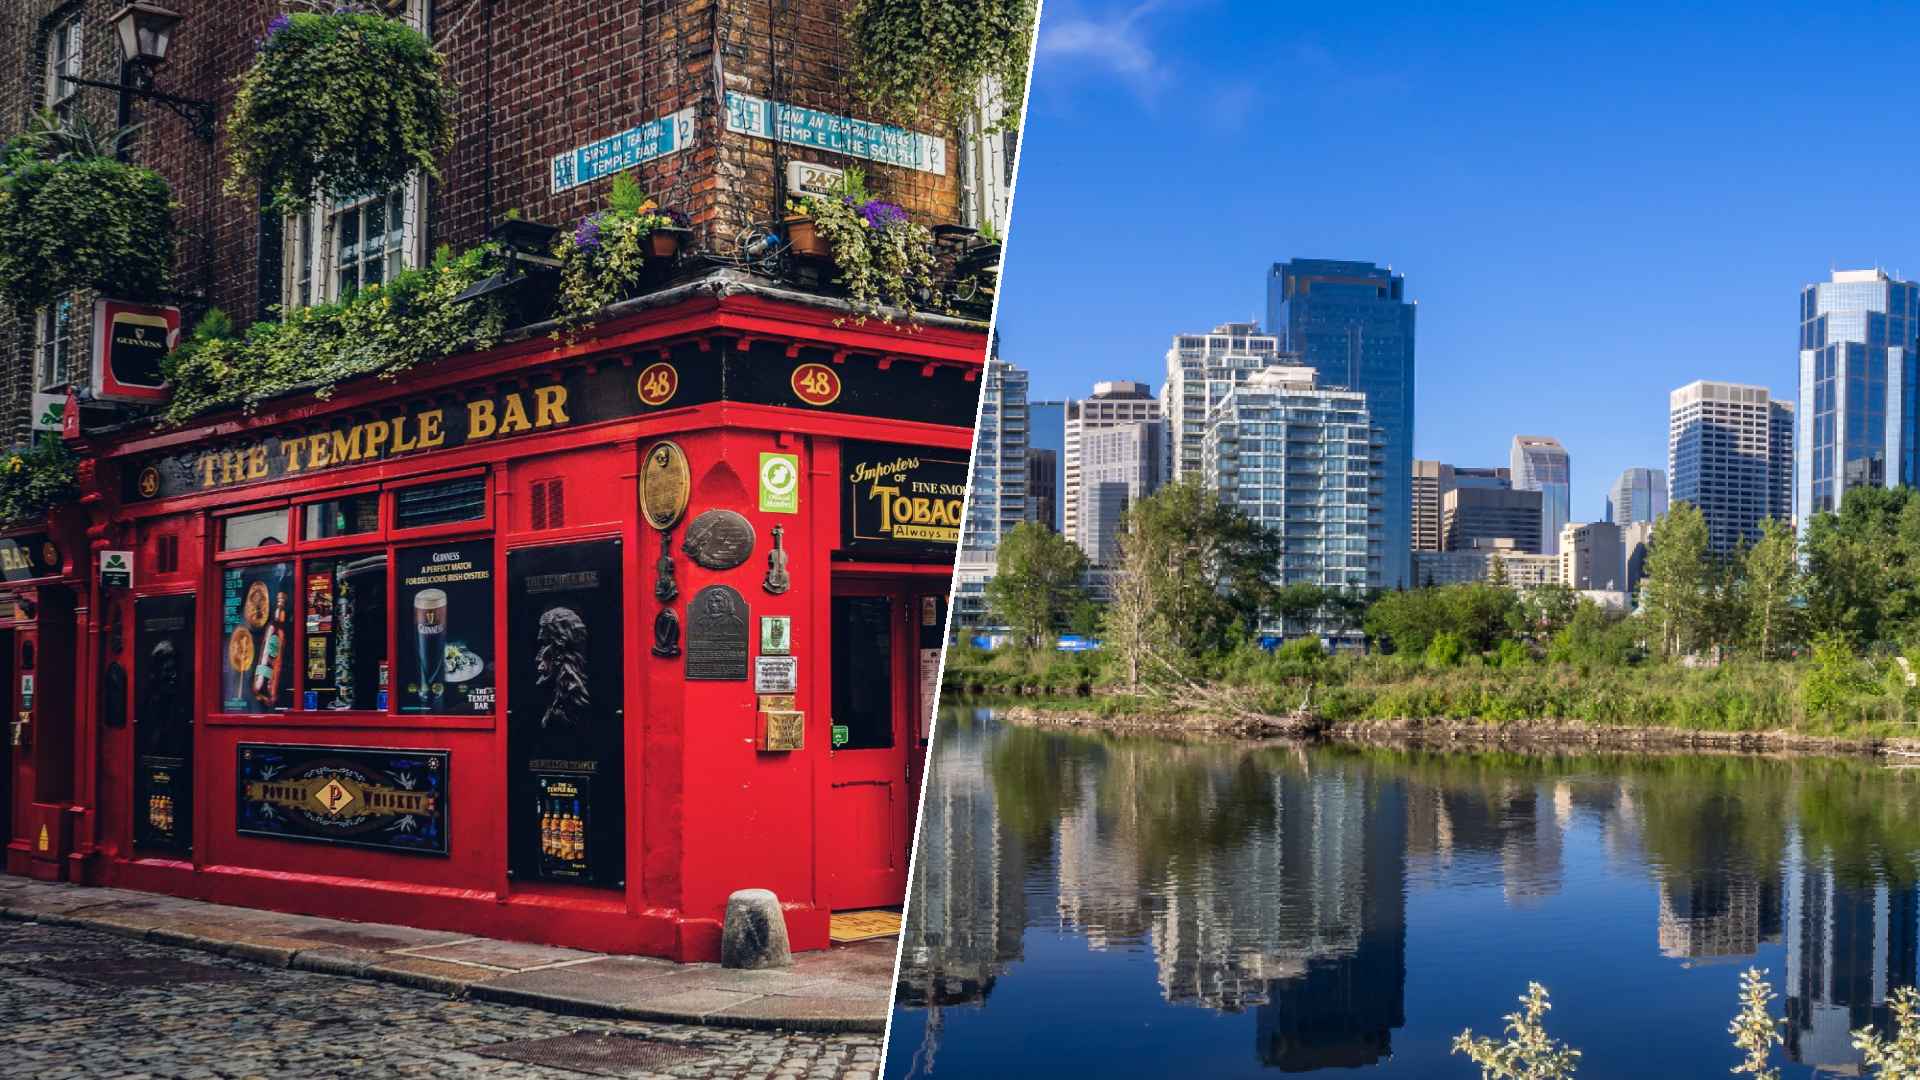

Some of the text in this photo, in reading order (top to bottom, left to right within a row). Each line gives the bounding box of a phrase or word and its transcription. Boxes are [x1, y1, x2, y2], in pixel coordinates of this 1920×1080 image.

[680, 119, 689, 140] 2
[808, 114, 824, 129] AN
[591, 151, 632, 175] TEMPLE
[636, 142, 658, 160] BAR
[116, 337, 162, 349] GUINNESS
[644, 371, 670, 397] 48
[800, 368, 830, 395] 48
[197, 384, 570, 487] THE TEMPLE BAR
[850, 457, 920, 485] Importers
[893, 474, 907, 482] OF
[911, 481, 938, 494] FINE
[869, 485, 964, 533] TOBAC
[895, 526, 942, 538] Always
[0, 546, 34, 570] BAR
[432, 551, 460, 562] GUINNESS
[421, 561, 472, 574] A PERFECT MATCH
[467, 694, 495, 702] TEMPLE
[474, 702, 489, 710] BAR
[262, 784, 307, 801] POWERS
